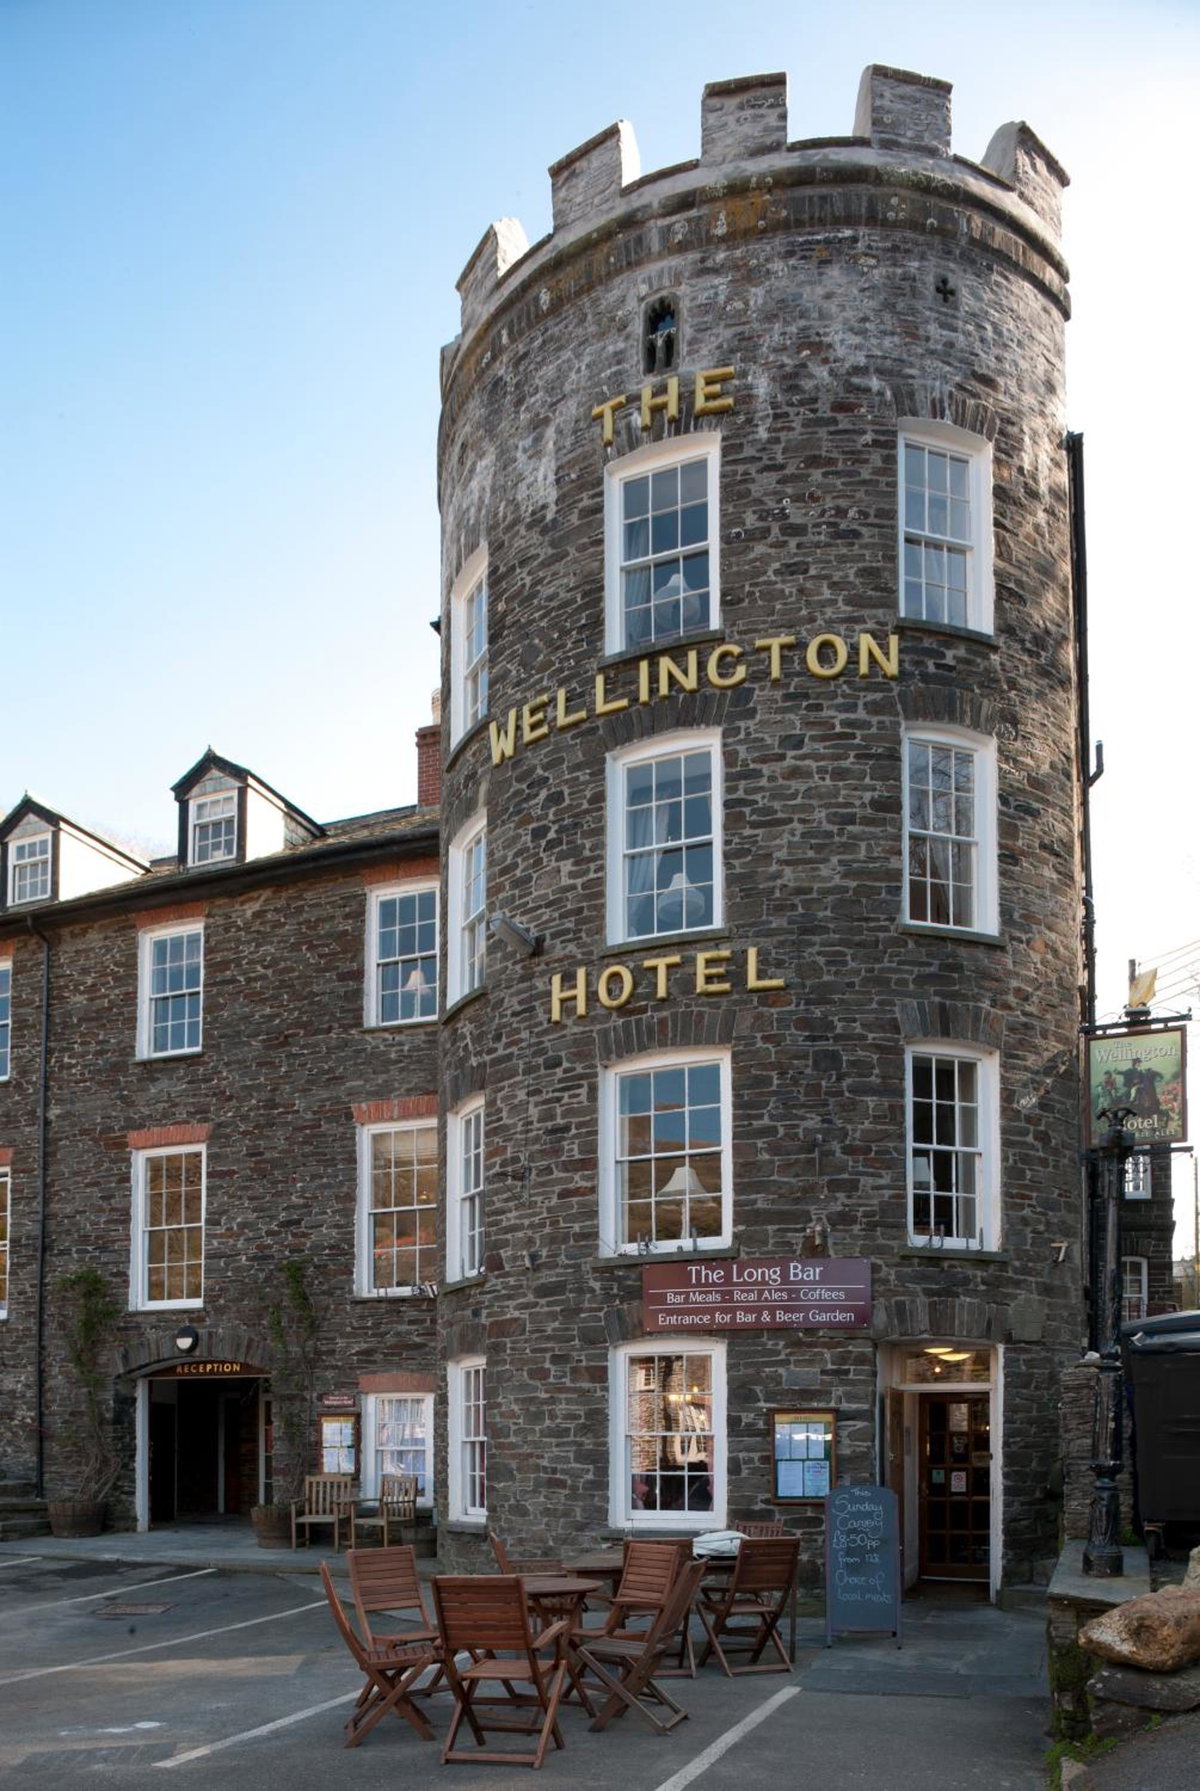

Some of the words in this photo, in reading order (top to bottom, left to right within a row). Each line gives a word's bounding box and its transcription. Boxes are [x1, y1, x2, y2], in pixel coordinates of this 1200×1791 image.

[592, 365, 737, 448] THE
[489, 631, 901, 768] WELLINGTON
[549, 946, 788, 1025] HOTEL
[1096, 1044, 1176, 1064] Wellington
[687, 1265, 725, 1284] The
[732, 1263, 781, 1285] Long
[789, 1263, 824, 1281] Bar
[667, 1292, 684, 1304] Bar
[689, 1290, 721, 1302] Meals
[733, 1290, 758, 1301] Real
[762, 1289, 788, 1300] Ales
[800, 1288, 845, 1300] Coffees
[658, 1313, 711, 1325] Entrance
[715, 1311, 732, 1323] for
[736, 1312, 757, 1323] Bar
[761, 1311, 771, 1323] &
[776, 1310, 805, 1322] Beer
[809, 1309, 855, 1322] Garden
[176, 1363, 241, 1374] RECEPTION
[832, 1494, 883, 1520] Sunday
[837, 1514, 884, 1538] Carvery
[838, 1551, 860, 1568] from
[836, 1569, 868, 1586] Choice
[868, 1571, 885, 1591] of
